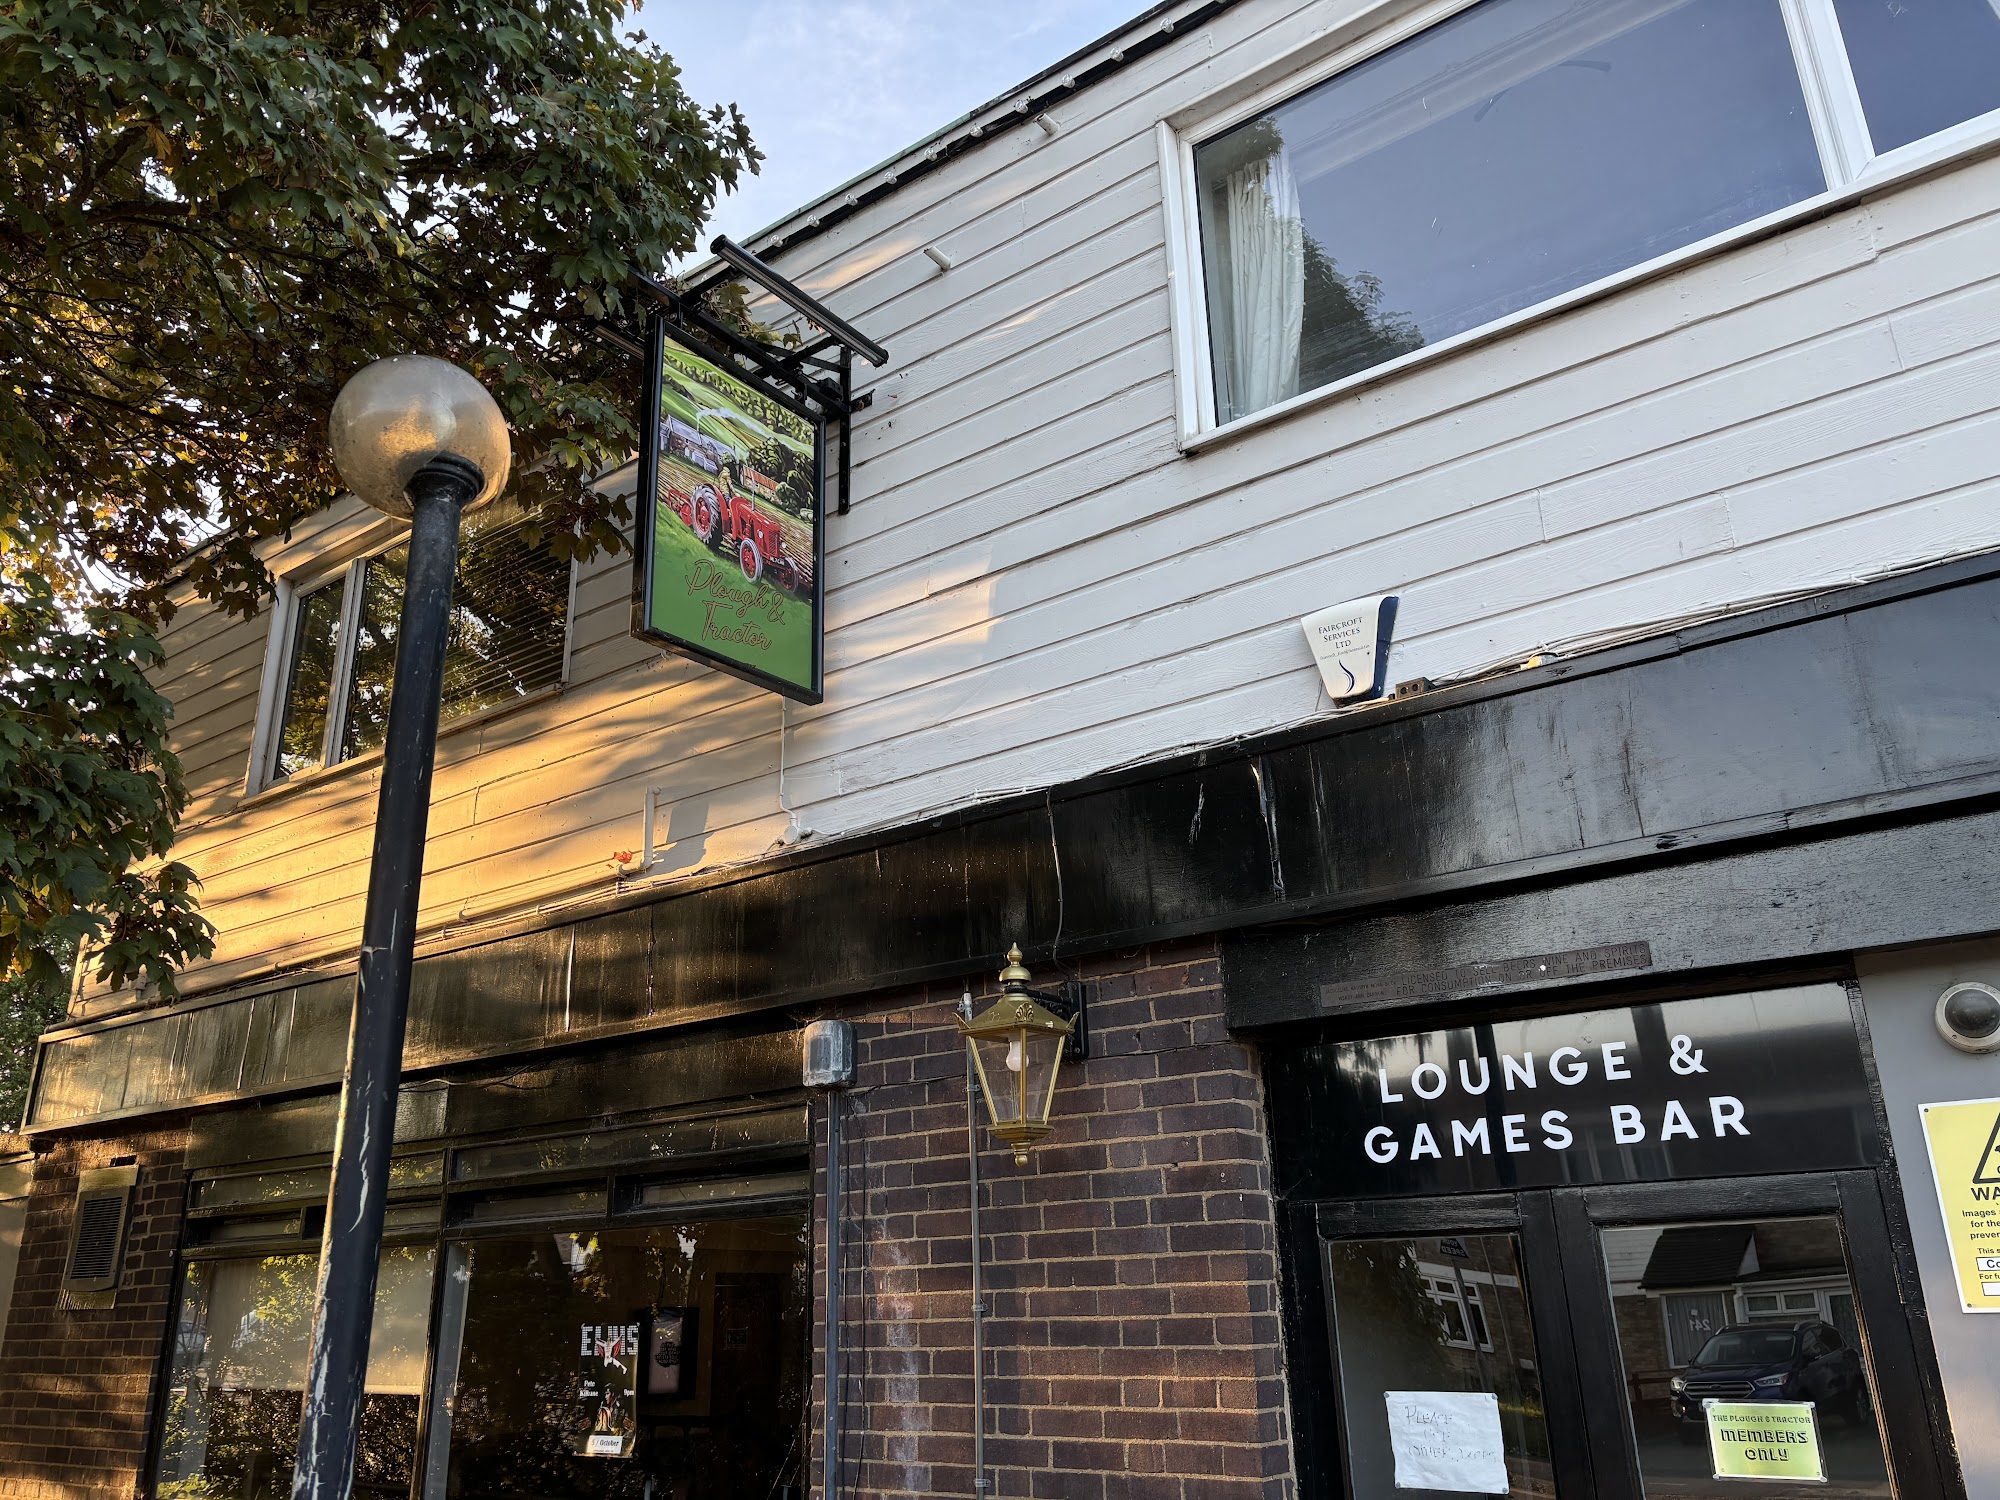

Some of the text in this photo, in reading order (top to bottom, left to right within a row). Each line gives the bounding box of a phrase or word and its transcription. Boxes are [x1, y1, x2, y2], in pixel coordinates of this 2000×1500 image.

[685, 558, 786, 625] Plough &
[702, 599, 773, 650] Tractor
[1318, 616, 1363, 635] FAIRCROFT
[1323, 627, 1361, 643] SERVICES
[1335, 639, 1352, 649] LTD
[1402, 969, 1448, 986] LICENSED
[1452, 967, 1467, 980] TO
[1473, 963, 1496, 979] SELL
[1503, 958, 1536, 973] BEERS
[1541, 953, 1569, 967] WINE
[1575, 950, 1597, 962] AND
[1605, 943, 1646, 959] SPIRITS
[1396, 983, 1416, 998] FOR
[1421, 973, 1492, 994] CONSUMPTION
[1498, 972, 1513, 983] ON
[1565, 962, 1587, 974] THE
[1592, 954, 1647, 971] PREMISES
[1378, 1034, 1709, 1104] LOUNGE &
[1363, 1095, 1751, 1164] GAMES BAR
[1962, 1209, 1997, 1219] Images
[1971, 1220, 1984, 1228] for
[1977, 1247, 1995, 1255] This
[623, 1388, 635, 1398] 9pm
[1712, 1414, 1728, 1422] THE
[1729, 1415, 1764, 1423] PLOUGH
[1771, 1415, 1812, 1424] TRACTOR
[1720, 1428, 1809, 1444] MEMBERS
[1744, 1447, 1790, 1462] ONLY
